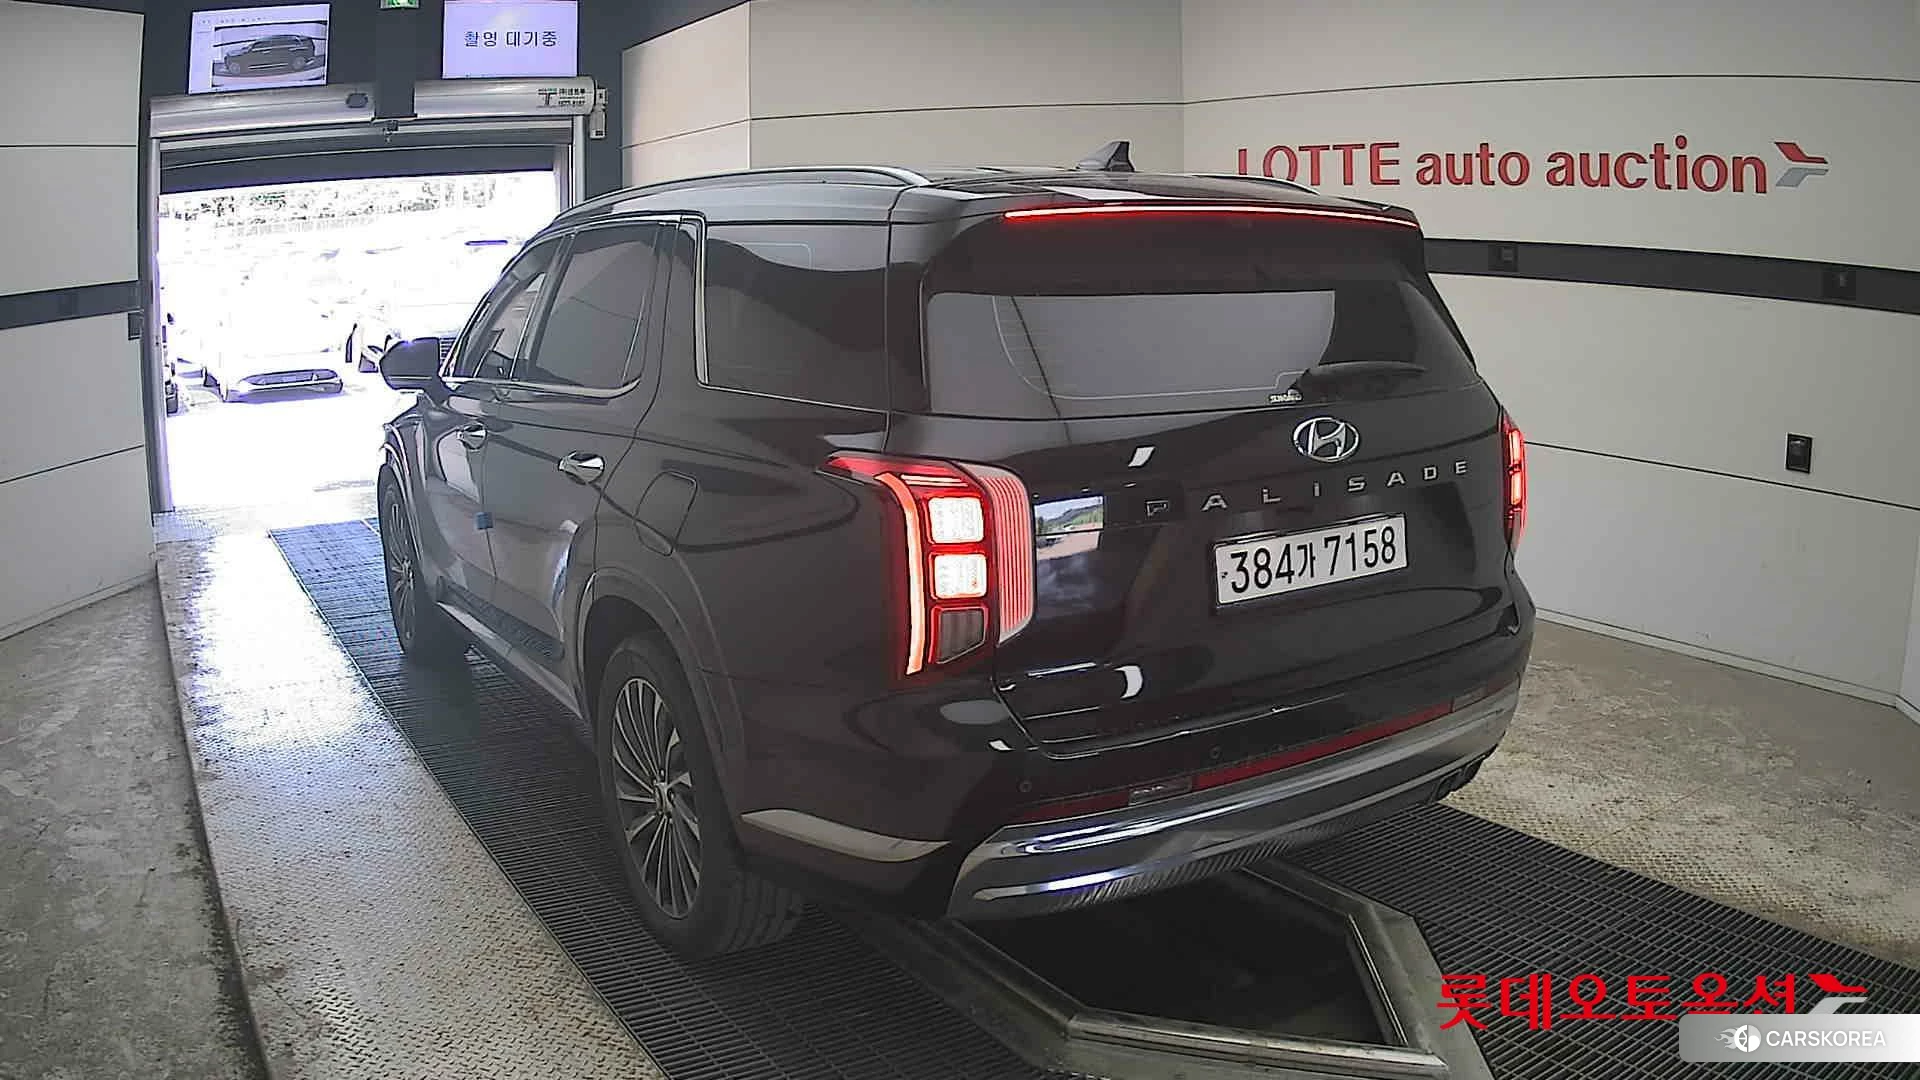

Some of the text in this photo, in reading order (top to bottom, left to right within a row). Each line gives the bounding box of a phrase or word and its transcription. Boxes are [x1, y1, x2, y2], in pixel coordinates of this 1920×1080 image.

[506, 31, 557, 47] 대기중
[1415, 142, 1530, 186] auto
[1546, 134, 1767, 194] auction
[1145, 460, 1468, 516] PALISADE
[1230, 525, 1396, 594] 384가 7158
